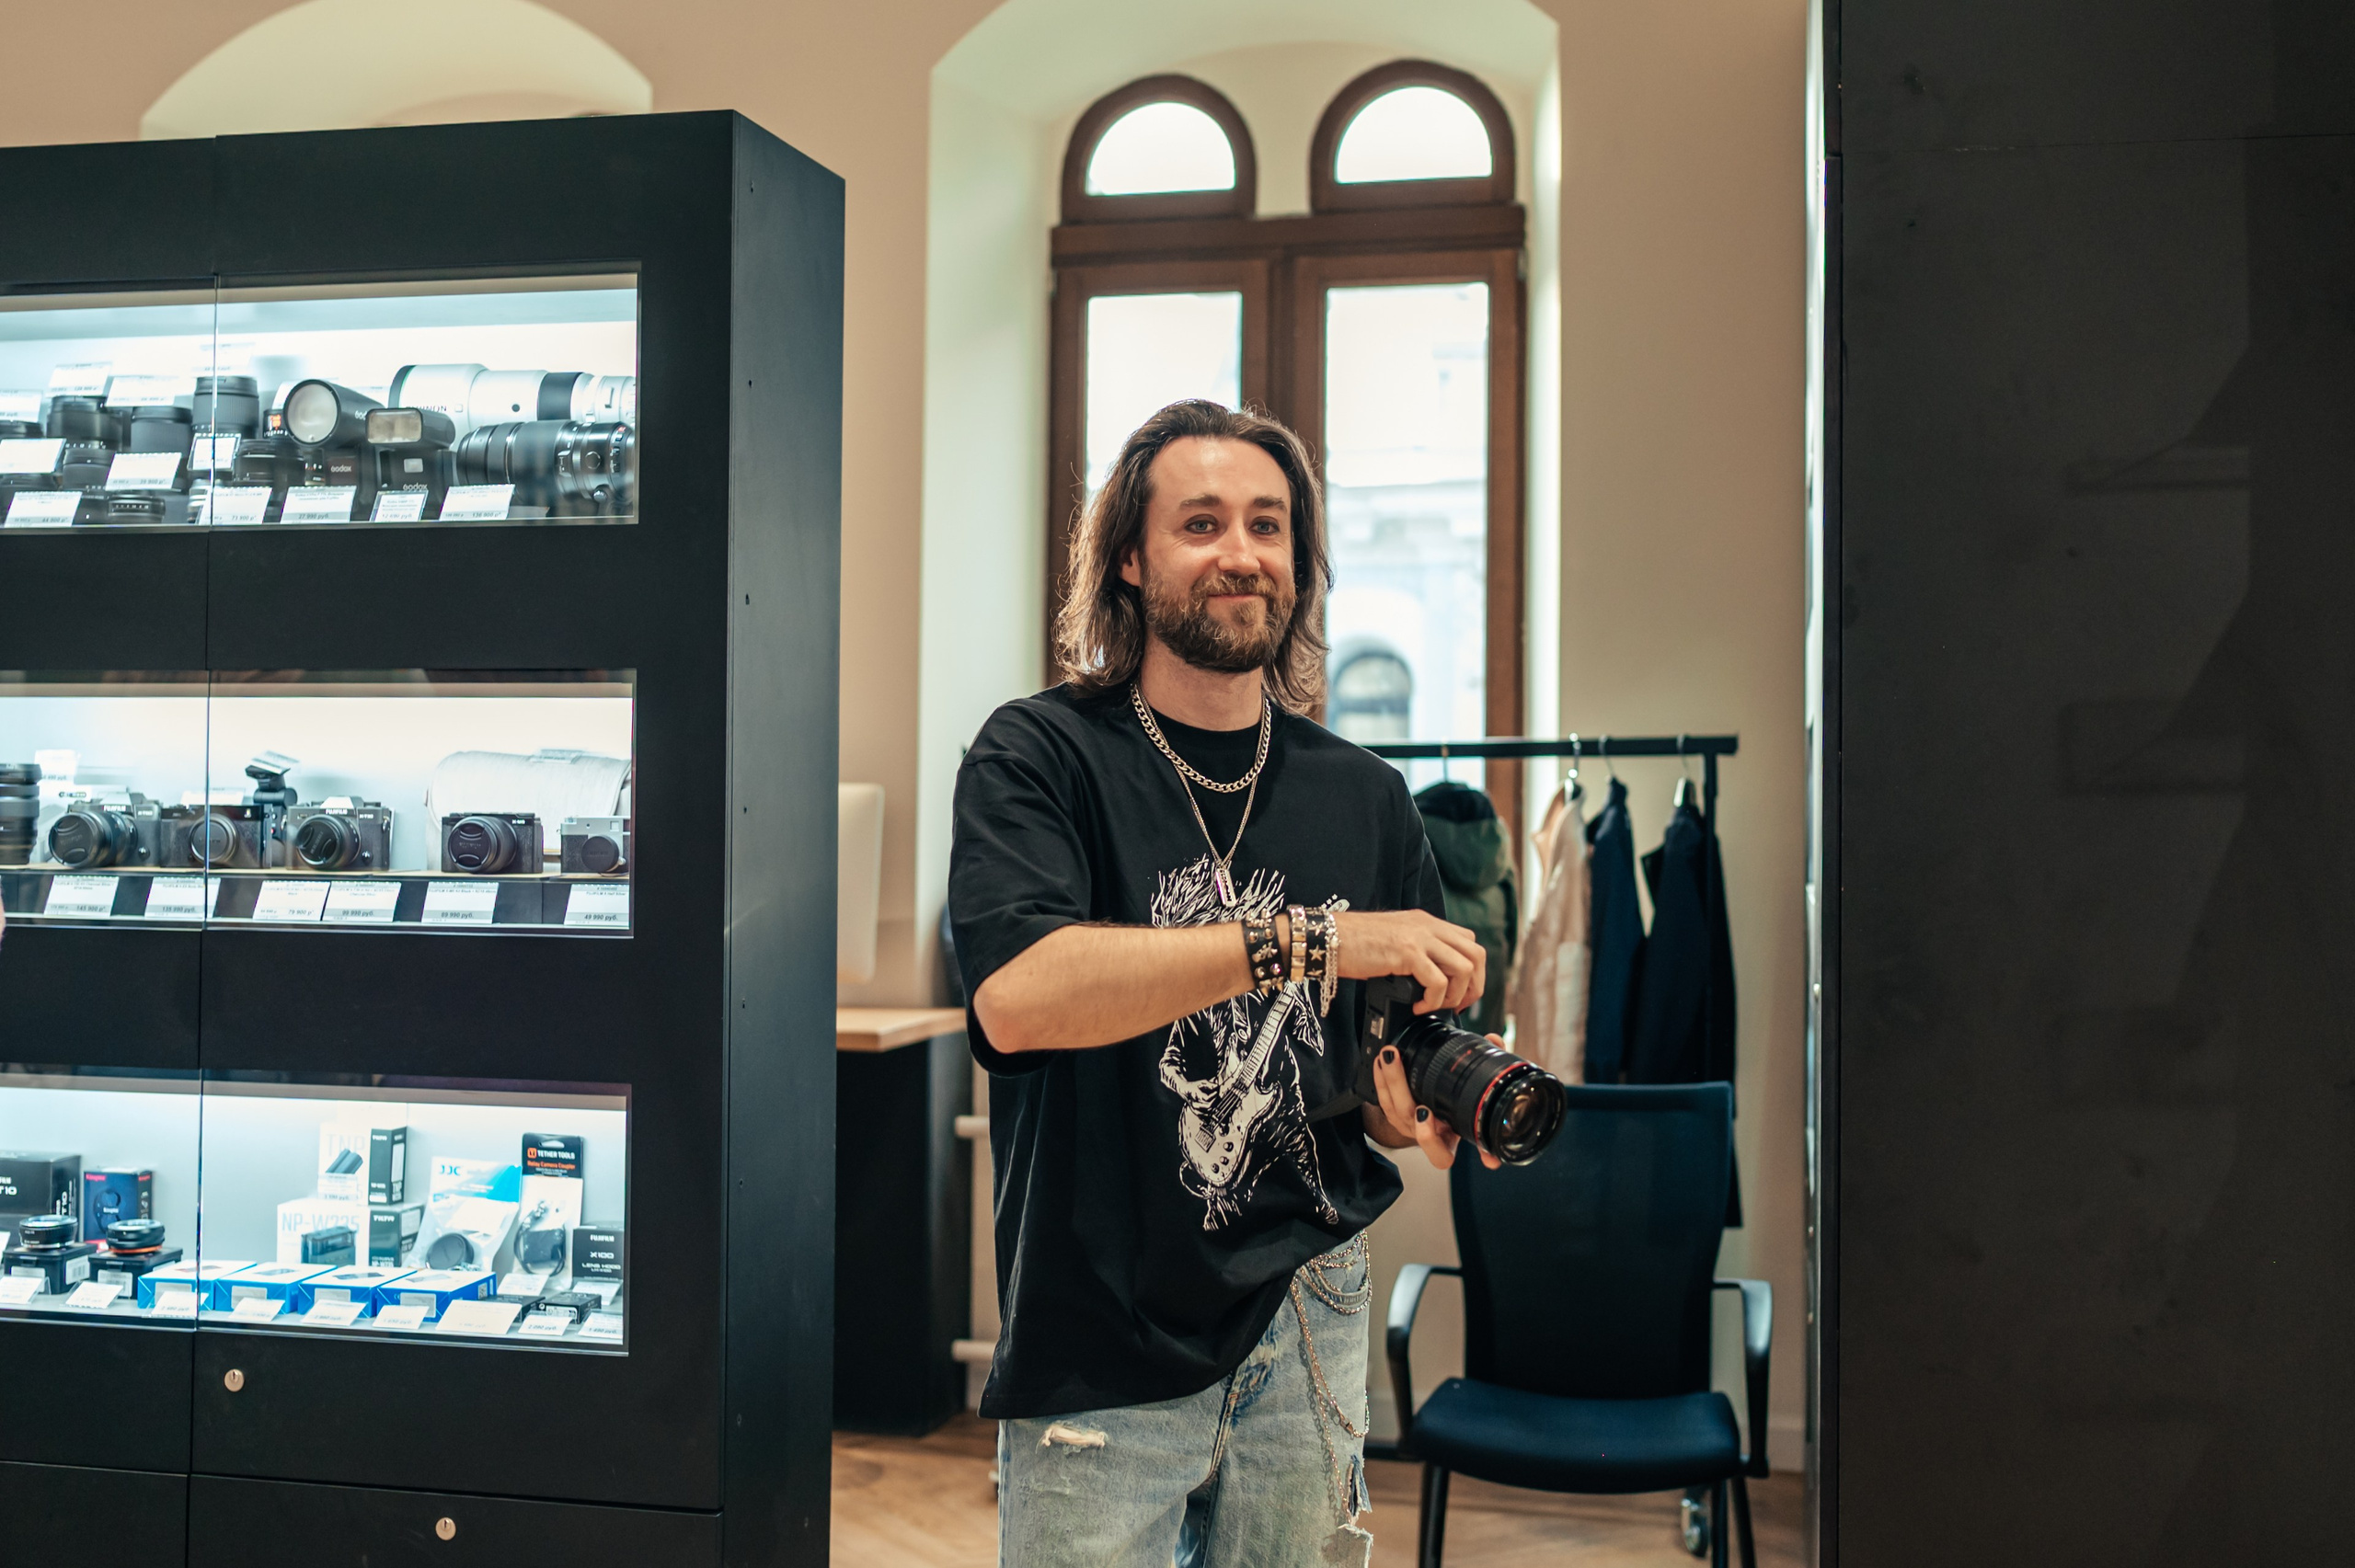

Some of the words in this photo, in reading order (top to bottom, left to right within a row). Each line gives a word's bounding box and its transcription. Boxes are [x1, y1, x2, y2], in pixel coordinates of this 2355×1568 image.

[330, 464, 352, 473] Godox
[403, 482, 429, 491] Godox
[537, 1150, 557, 1159] TETHER
[557, 1150, 576, 1160] TOOLS
[439, 1164, 461, 1176] JJC
[281, 1212, 361, 1233] NP-W235
[590, 1234, 615, 1242] FUJIFILM
[590, 1251, 615, 1259] X100
